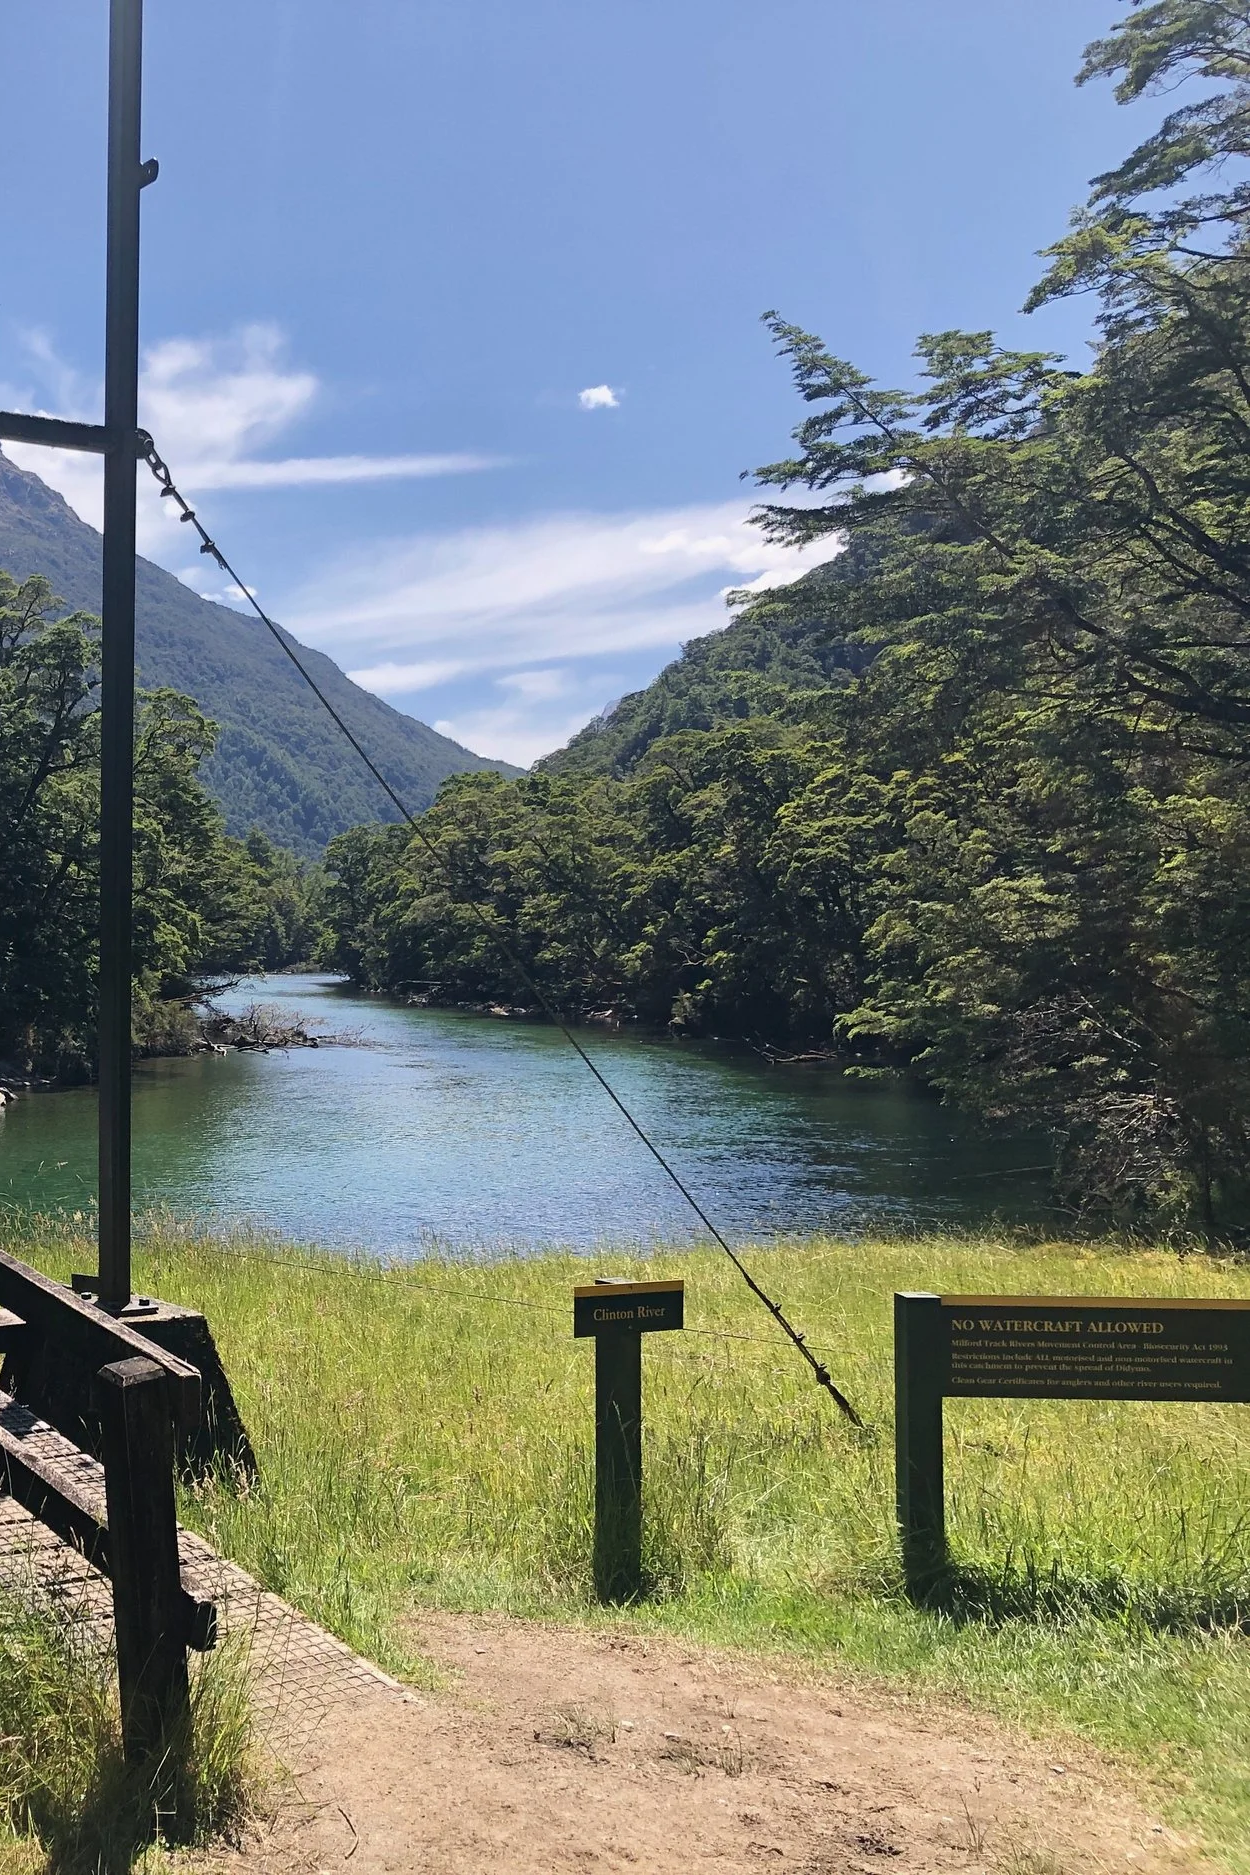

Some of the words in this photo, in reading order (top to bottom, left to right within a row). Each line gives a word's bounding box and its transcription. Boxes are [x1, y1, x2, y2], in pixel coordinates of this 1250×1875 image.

[593, 1307, 634, 1321] Clinton
[637, 1305, 666, 1318] River
[951, 1319, 975, 1331] NO
[978, 1320, 1083, 1332] WATERCRAFT
[1087, 1321, 1164, 1333] ALLOWED
[951, 1339, 983, 1347] Milford
[1143, 1343, 1190, 1351] Biosecurity
[1059, 1363, 1073, 1371] the
[1075, 1364, 1103, 1372] spread
[998, 1377, 1045, 1385] Certificates
[1061, 1378, 1092, 1387] anglers
